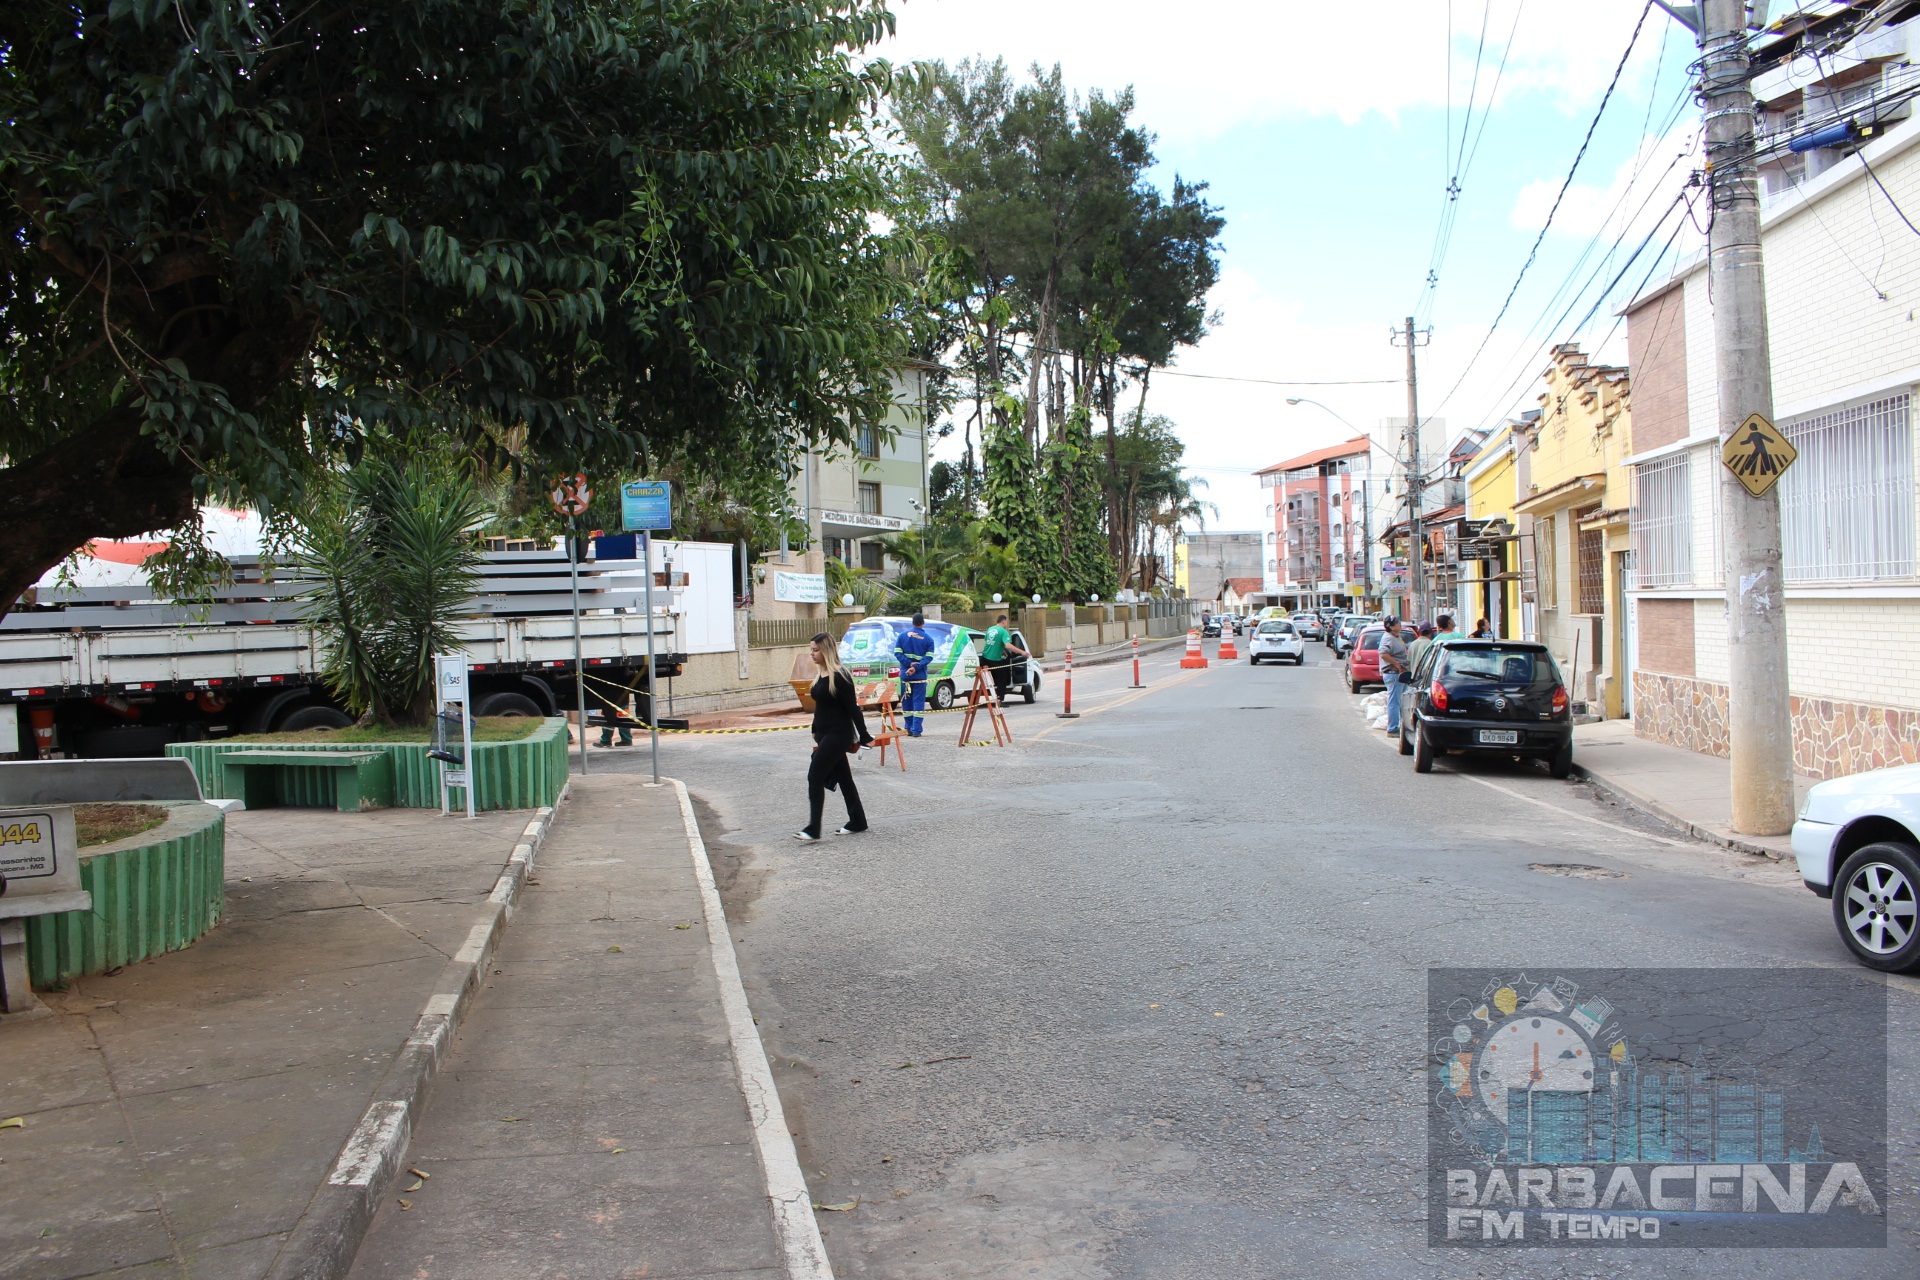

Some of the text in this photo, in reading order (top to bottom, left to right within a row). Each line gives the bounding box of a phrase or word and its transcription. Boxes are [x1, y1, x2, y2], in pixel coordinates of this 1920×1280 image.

[627, 487, 664, 496] CARAZZA
[824, 512, 848, 522] MEDICINA
[848, 515, 856, 524] DE
[856, 515, 881, 526] BARBACENA
[449, 676, 460, 684] SAS
